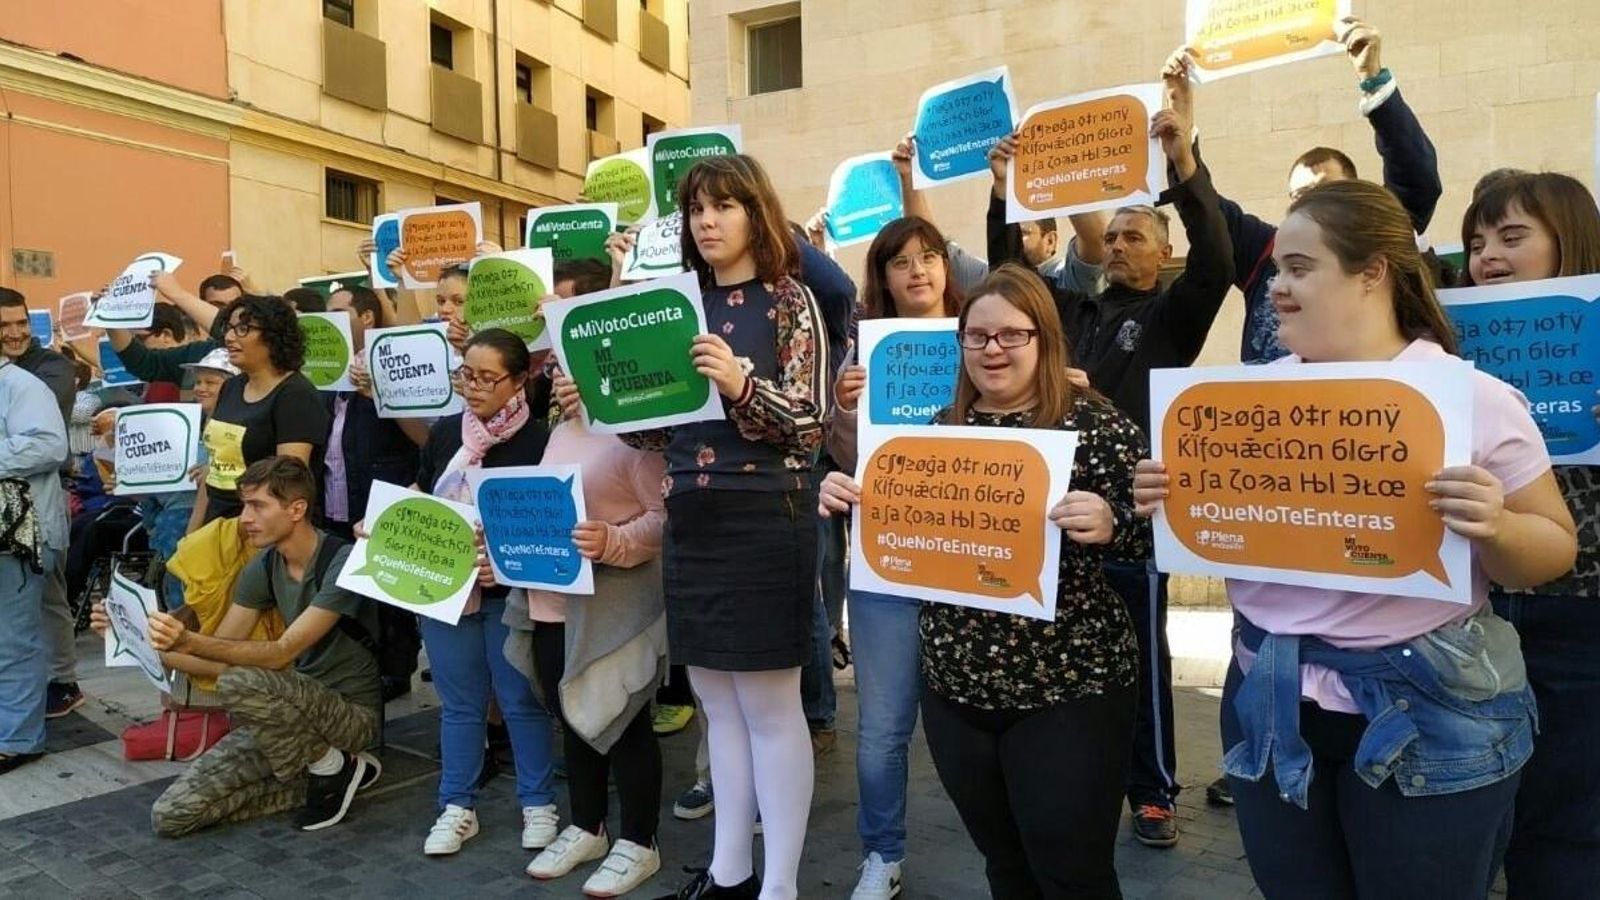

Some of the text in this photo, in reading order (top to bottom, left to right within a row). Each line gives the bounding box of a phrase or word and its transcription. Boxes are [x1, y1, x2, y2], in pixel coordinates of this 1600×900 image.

[115, 274, 133, 286] OTO
[113, 282, 147, 297] CUENTA
[569, 306, 683, 340] #MiVotoCuenta
[379, 343, 392, 357] MI
[595, 348, 613, 364] MI
[379, 353, 411, 370] VOTO
[597, 359, 639, 378] VOTO
[388, 362, 436, 382] CUENTA
[611, 370, 677, 393] CUENTA
[118, 431, 146, 447] VOTO
[125, 440, 172, 459] CUENTA
[1189, 502, 1396, 531] #QueNoTeEnteras
[1211, 530, 1244, 543] Plena
[499, 543, 570, 557] #QueNoTeEnteras
[877, 532, 1012, 560] #QueNoTeEnteras
[373, 554, 454, 586] #QueNoTeEnteras
